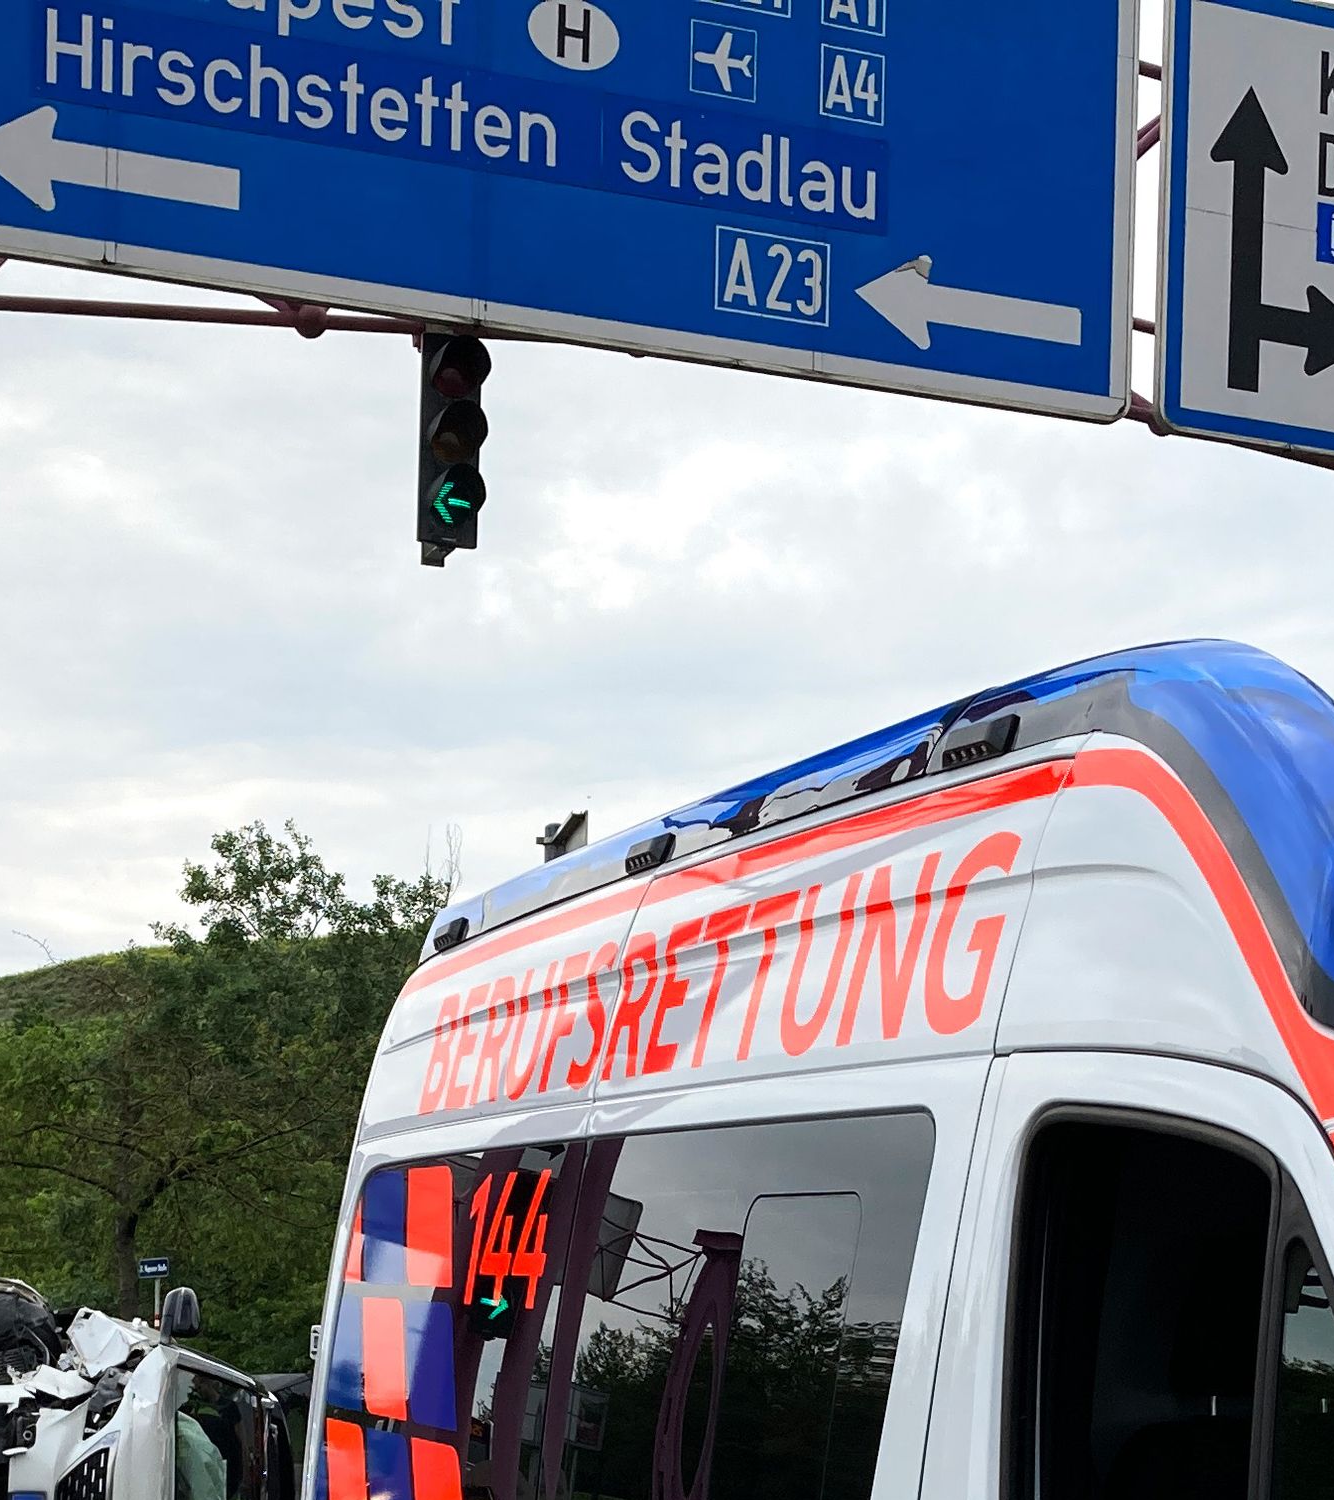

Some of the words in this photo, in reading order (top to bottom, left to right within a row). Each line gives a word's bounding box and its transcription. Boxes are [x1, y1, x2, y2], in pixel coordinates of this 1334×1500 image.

[556, 4, 590, 64] H
[825, 55, 879, 117] A4
[46, 8, 557, 167] Hirschstetten
[621, 111, 877, 221] Stadlau
[722, 237, 822, 316] A23
[418, 832, 1021, 1115] BERUFSRETTUNG
[465, 1169, 552, 1309] 144
